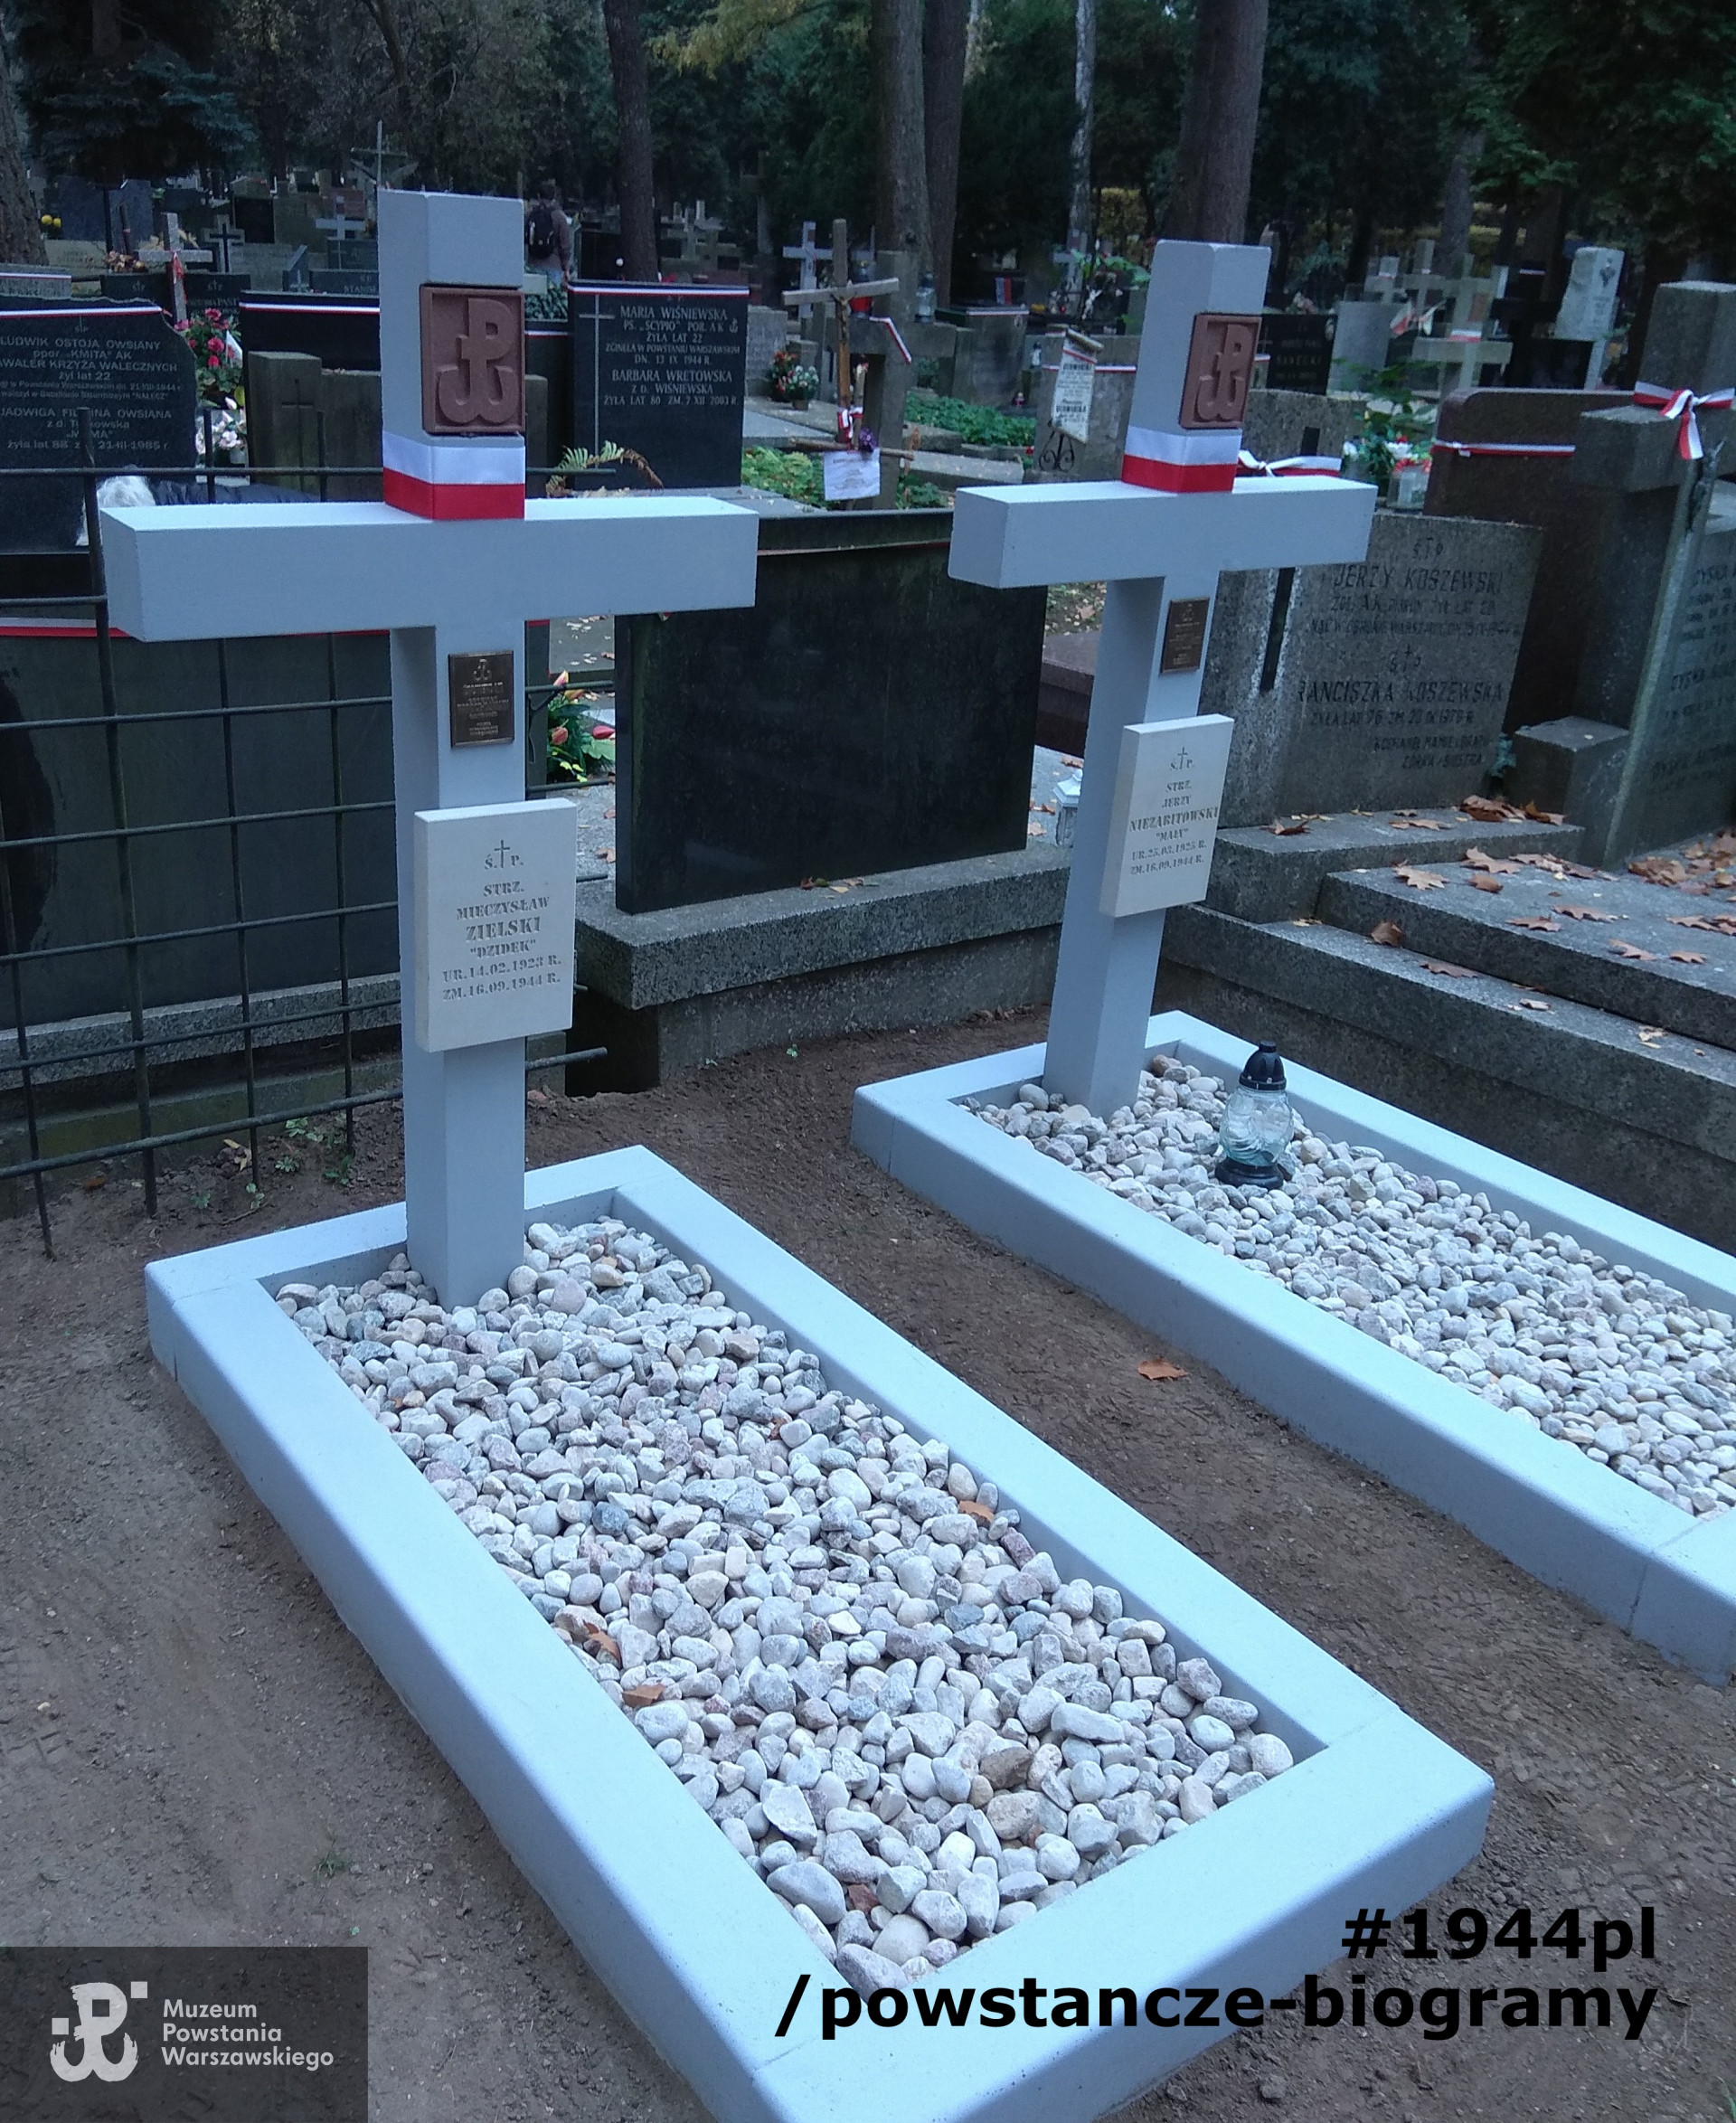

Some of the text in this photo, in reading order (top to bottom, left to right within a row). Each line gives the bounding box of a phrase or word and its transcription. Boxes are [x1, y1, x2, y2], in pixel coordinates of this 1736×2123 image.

[620, 305, 728, 320] MARIA WIŚNIEWSKA
[0, 335, 161, 351] LUDWIK OSTOJA OWSIANY
[672, 333, 687, 343] LAT
[693, 333, 703, 344] 22
[115, 351, 132, 360] AK
[0, 358, 177, 373] WALER KRZYŻA WALECZNYCH
[78, 371, 91, 381] lat
[95, 372, 110, 381] 22
[612, 369, 660, 382] BARBARA
[656, 382, 713, 394] WIŚNIEWSKA
[630, 395, 646, 405] LAT
[0, 407, 172, 420] JADWIGA FILINA OWSIANA
[33, 439, 49, 449] lat
[1334, 563, 1505, 595] JERZY KOSZEWSKI
[1161, 795, 1192, 809] JERZY
[1130, 806, 1219, 833] NIEZABITOWSKI
[483, 881, 524, 897] STRZ.
[457, 896, 550, 920] MIECZYSŁAW
[466, 916, 541, 941] ZIELSKI
[470, 939, 536, 958] "DZIDEK"
[548, 954, 562, 966] R.
[547, 972, 561, 984] R.
